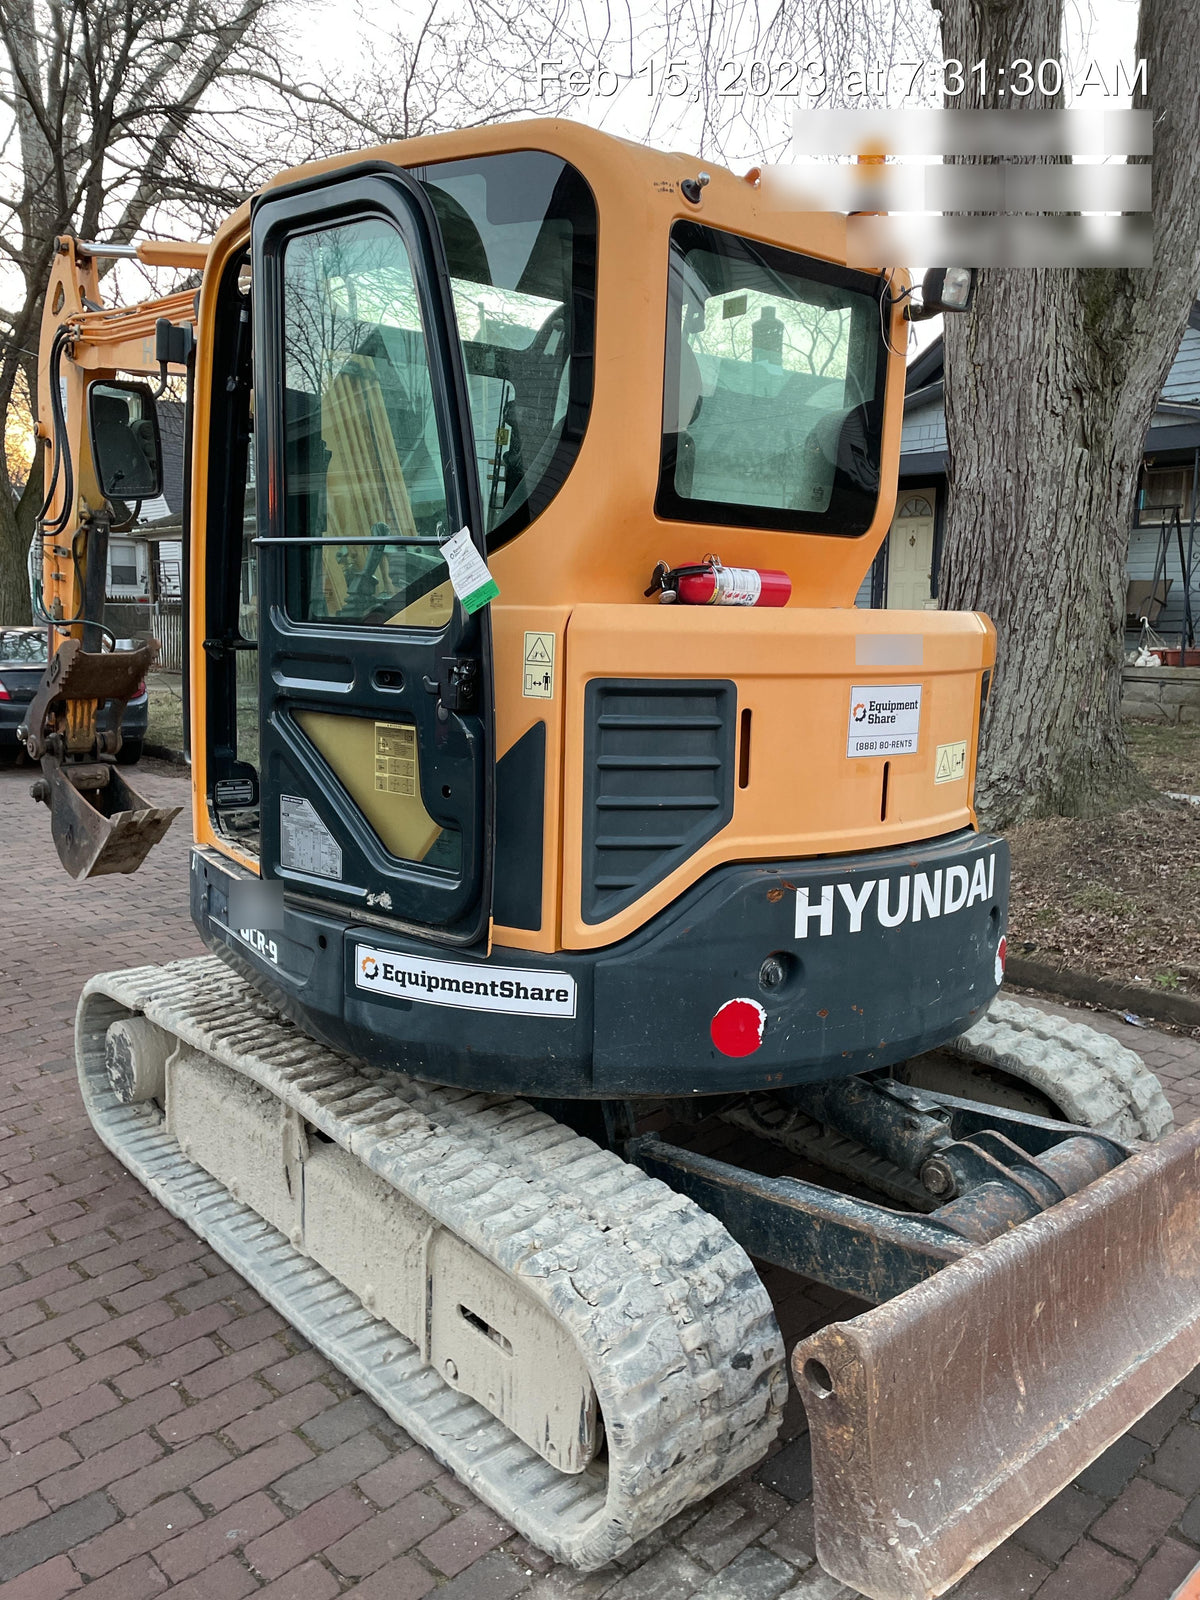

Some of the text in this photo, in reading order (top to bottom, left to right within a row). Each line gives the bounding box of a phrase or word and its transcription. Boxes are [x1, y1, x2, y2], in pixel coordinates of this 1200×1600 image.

[869, 700, 918, 713] Equipment
[868, 713, 896, 725] Share
[856, 740, 912, 751] (888) 80-RENTS
[794, 853, 996, 939] HYUNDAI
[382, 963, 569, 1003] EquipmentShare
